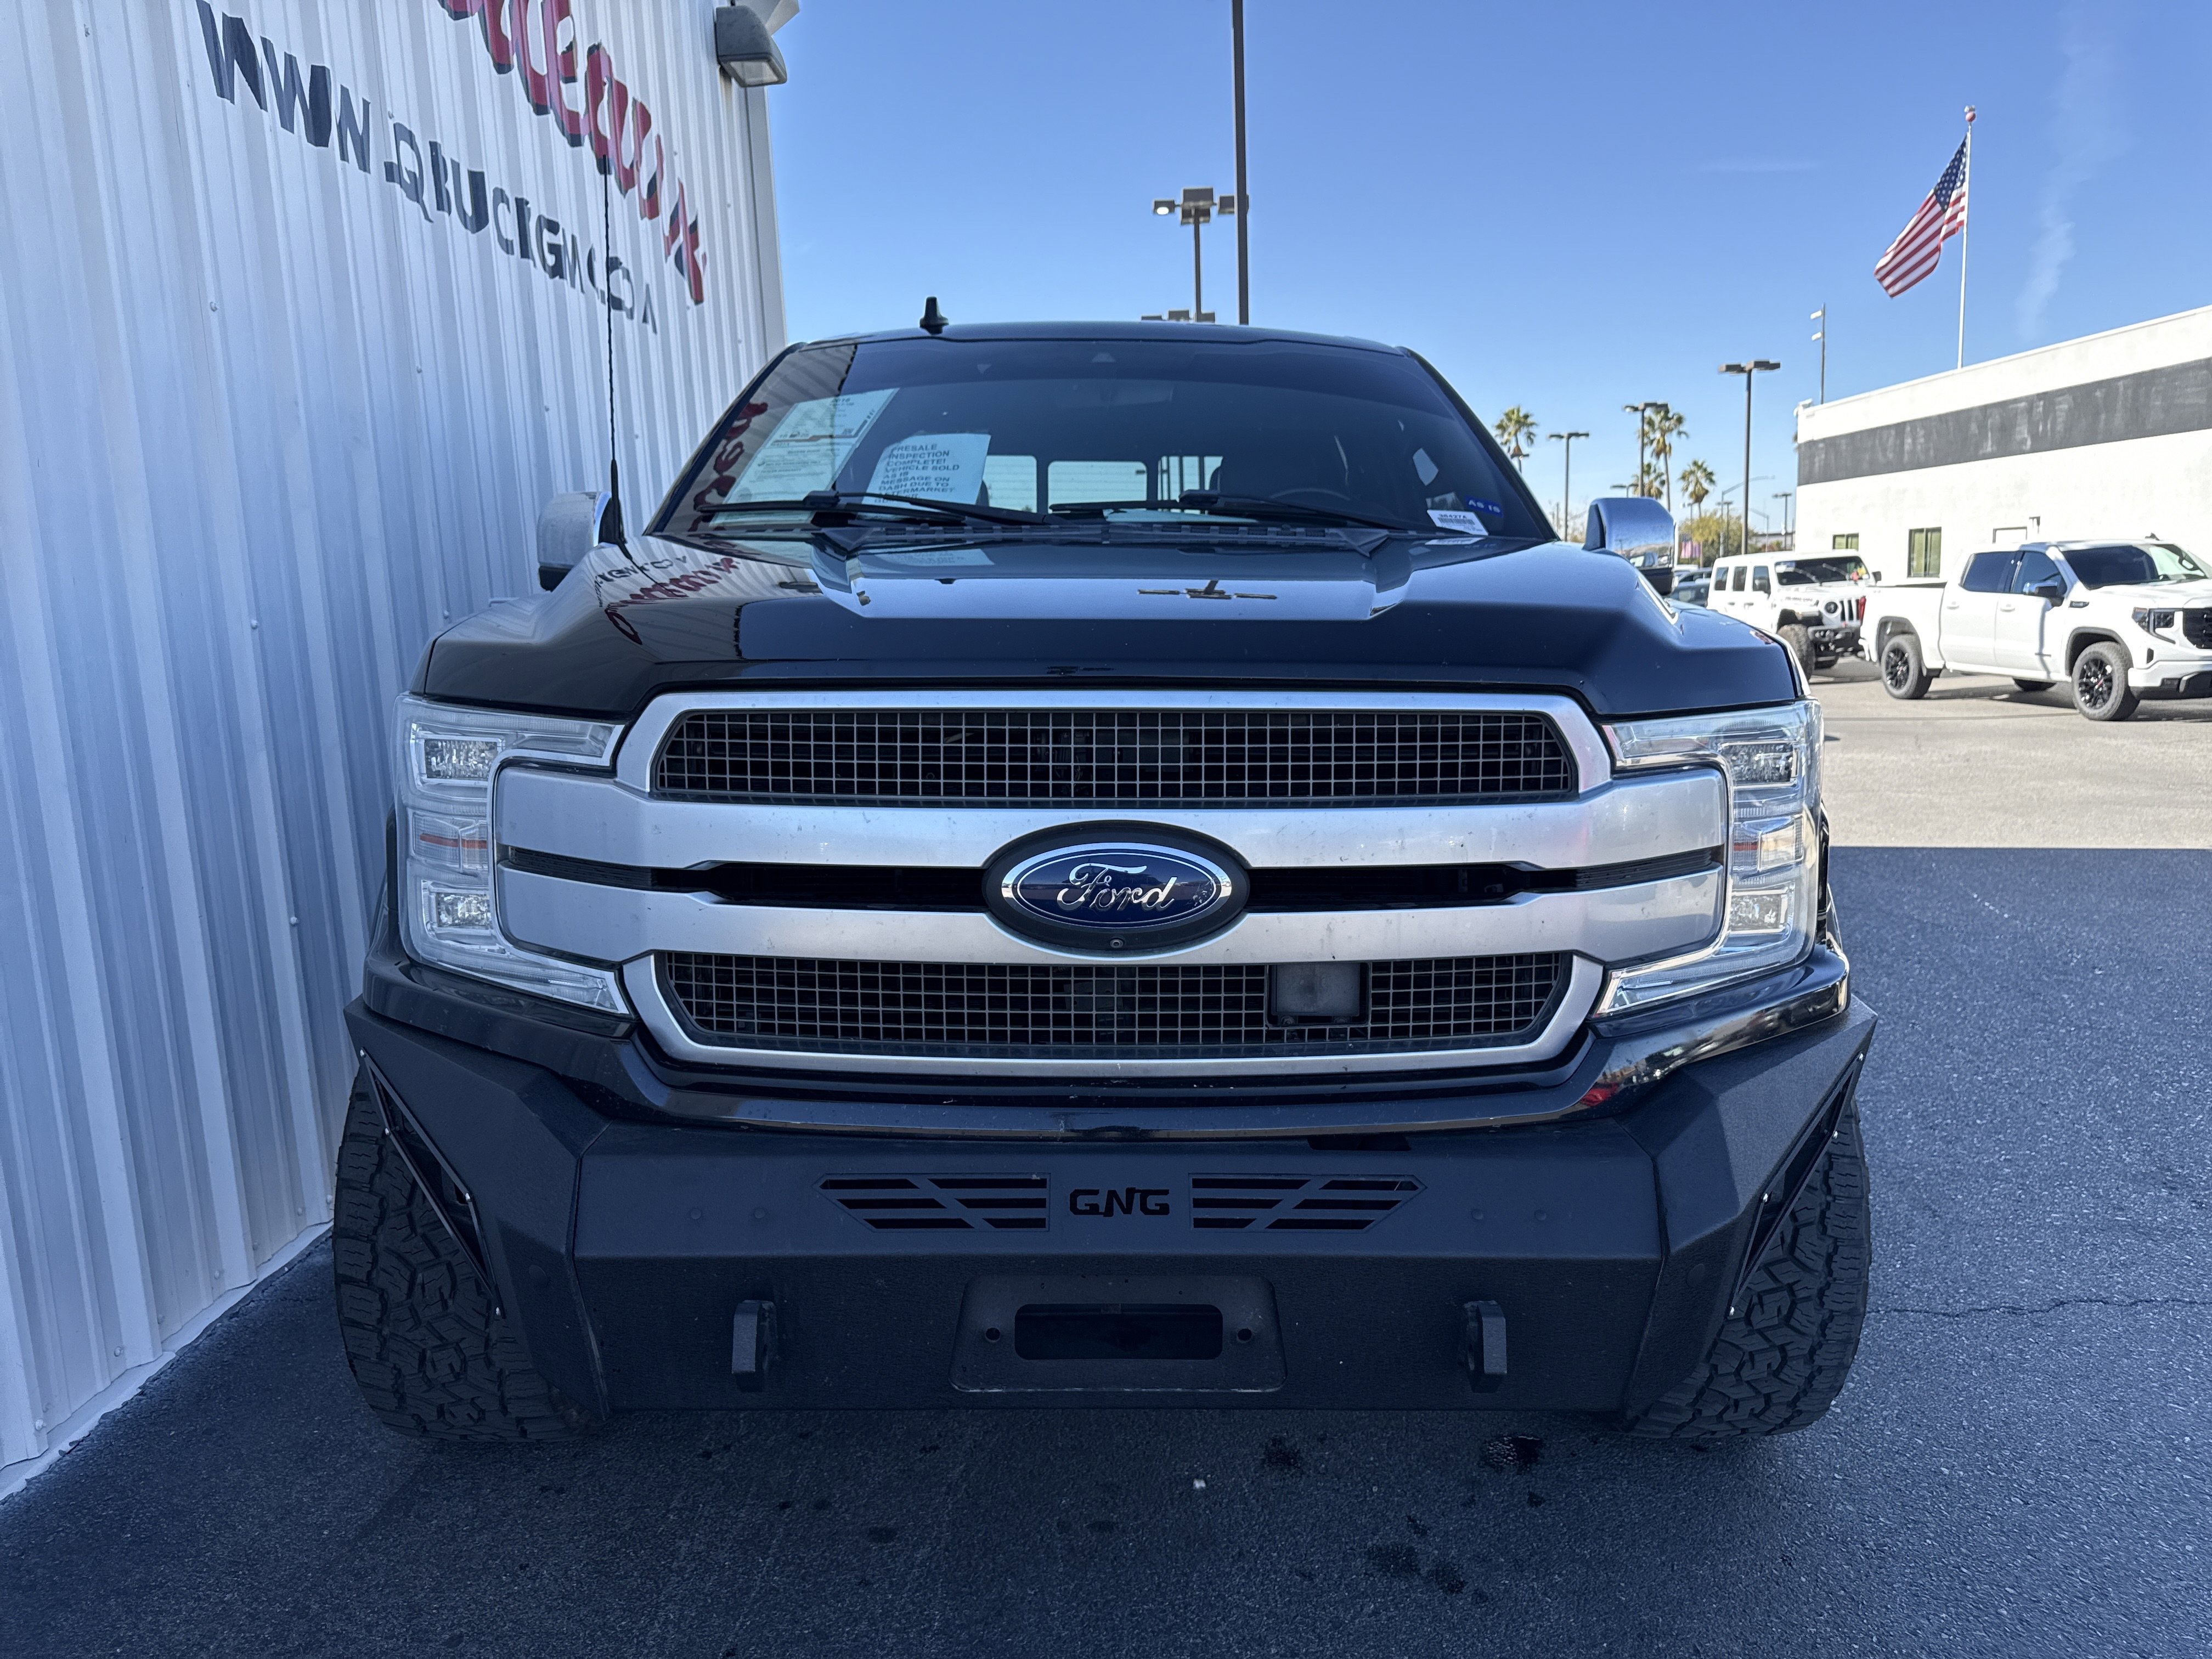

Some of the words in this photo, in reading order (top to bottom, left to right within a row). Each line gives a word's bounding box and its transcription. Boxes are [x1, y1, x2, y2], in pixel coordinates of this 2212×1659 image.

[891, 444, 938, 454] PRESALE
[889, 450, 950, 460] INSPECTION
[879, 487, 955, 497] TERMARKET
[1057, 862, 1178, 912] Ford
[1069, 1187, 1170, 1217] GNG
